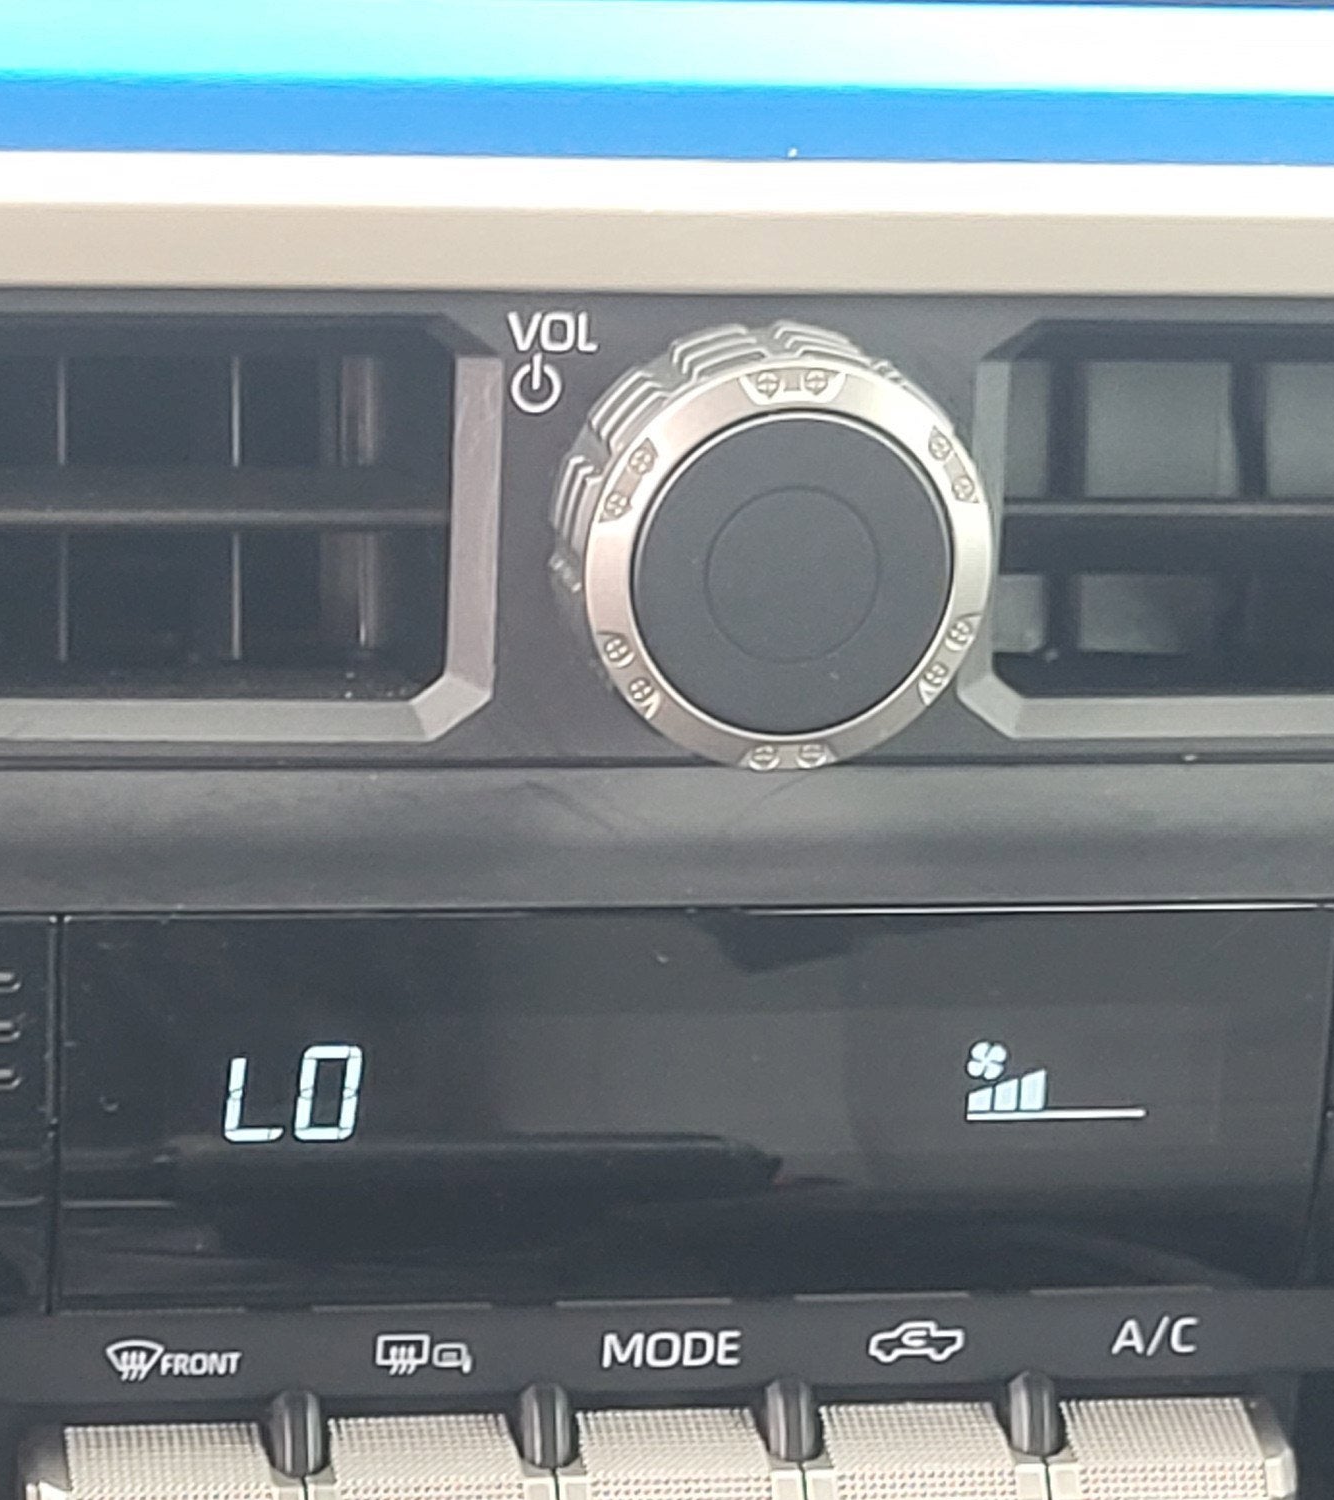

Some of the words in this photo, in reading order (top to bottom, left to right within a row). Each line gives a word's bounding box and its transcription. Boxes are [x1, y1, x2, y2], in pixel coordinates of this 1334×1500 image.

[507, 311, 599, 352] VOL
[601, 1330, 742, 1369] MODE
[1111, 1316, 1198, 1356] A/C
[160, 1352, 243, 1376] FRONT
